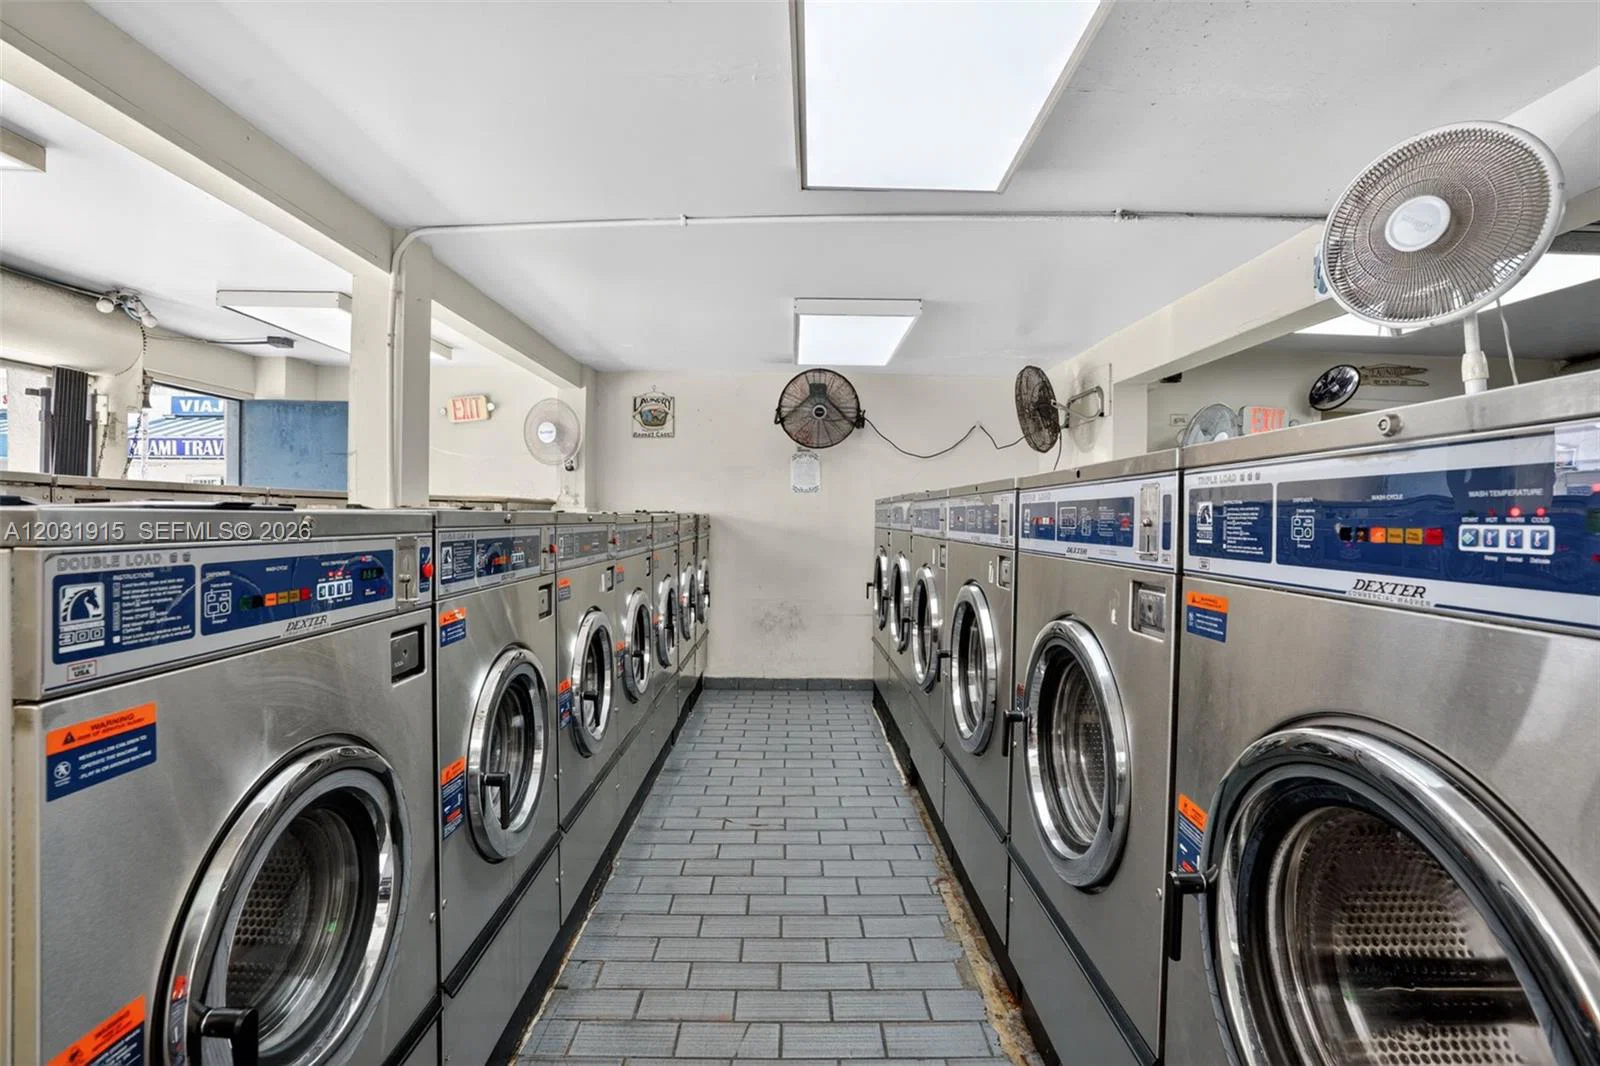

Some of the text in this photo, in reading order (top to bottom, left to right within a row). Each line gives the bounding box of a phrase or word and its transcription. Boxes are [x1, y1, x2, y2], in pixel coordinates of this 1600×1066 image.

[452, 398, 481, 421] EXIT
[632, 396, 673, 412] LAUNDRY
[1250, 407, 1286, 433] EXIT
[1468, 488, 1544, 498] WASH TEMPERATURE
[57, 553, 162, 572] DOUBLE LOAD
[1352, 578, 1427, 599] DEXTER
[286, 615, 328, 632] DEXTER
[90, 712, 135, 731] WARNING
